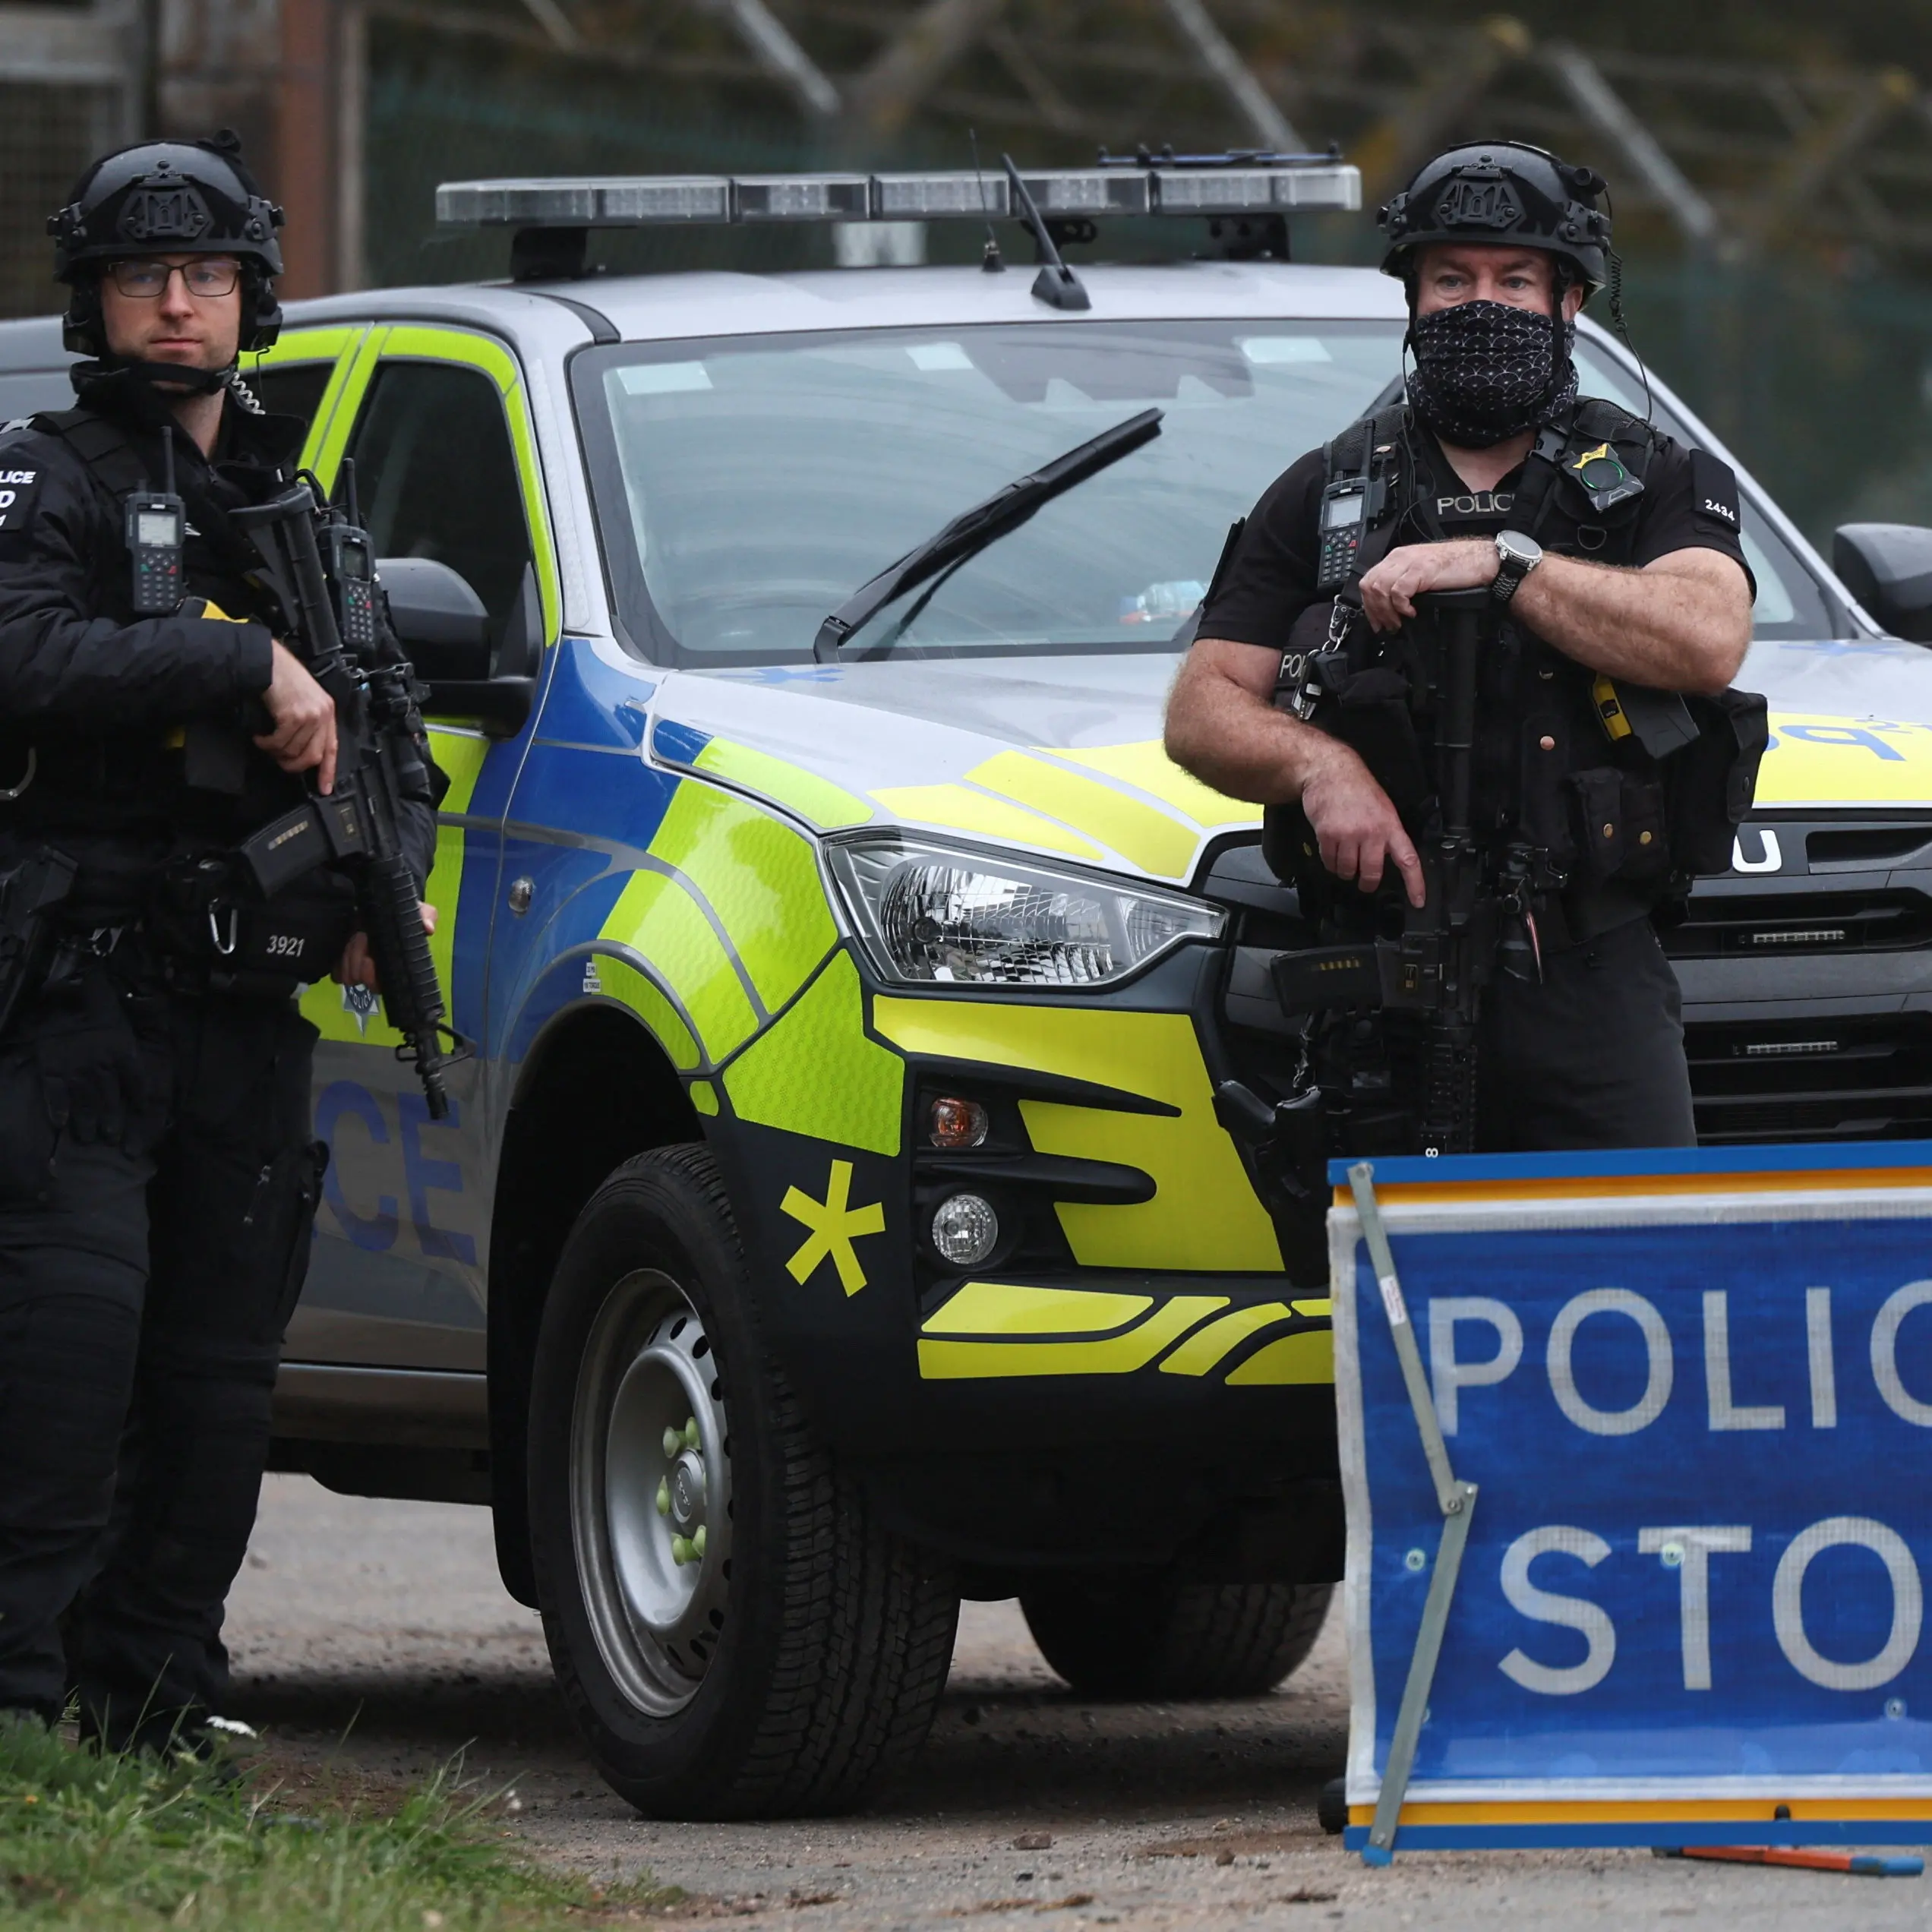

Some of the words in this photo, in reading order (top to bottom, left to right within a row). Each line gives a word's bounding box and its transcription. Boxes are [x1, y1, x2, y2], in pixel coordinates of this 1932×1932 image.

[1437, 493, 1516, 516] POLIC
[1704, 499, 1735, 522] 2434
[266, 934, 305, 958] 3921
[313, 1080, 478, 1267] CE
[1498, 1515, 1924, 1696] STO
